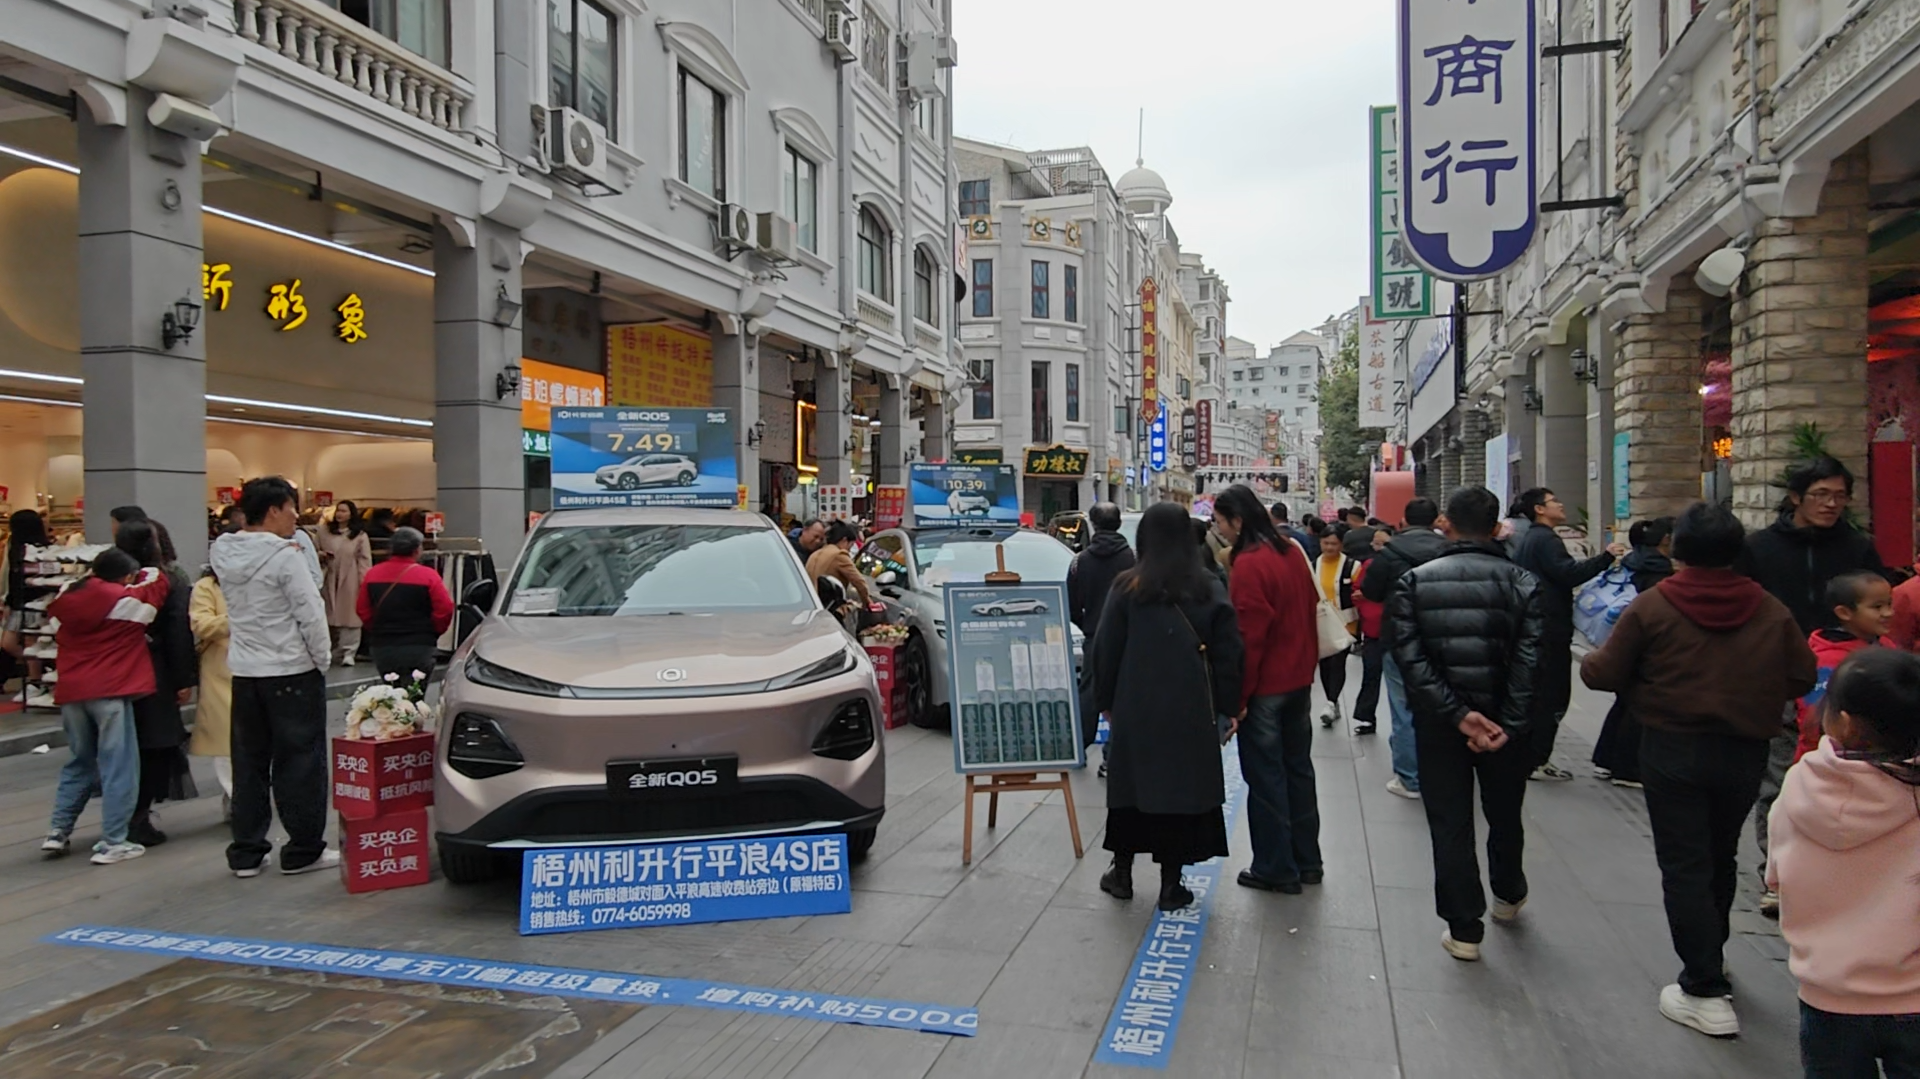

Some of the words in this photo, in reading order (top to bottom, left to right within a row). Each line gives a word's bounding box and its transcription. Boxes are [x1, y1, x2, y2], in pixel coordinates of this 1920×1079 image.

[1421, 0, 1518, 206] 商行
[1367, 331, 1387, 412] 茶船古道
[616, 411, 671, 421] 全新Q05
[607, 433, 674, 452] 7.49
[947, 479, 984, 490] 10.39
[336, 753, 369, 774] 买央企
[383, 751, 433, 773] 买央企
[628, 769, 718, 789] 全新Q05
[359, 827, 419, 850] 买央企
[359, 855, 419, 878] 买负责
[531, 839, 842, 888] 梧州利升行平浪4S店
